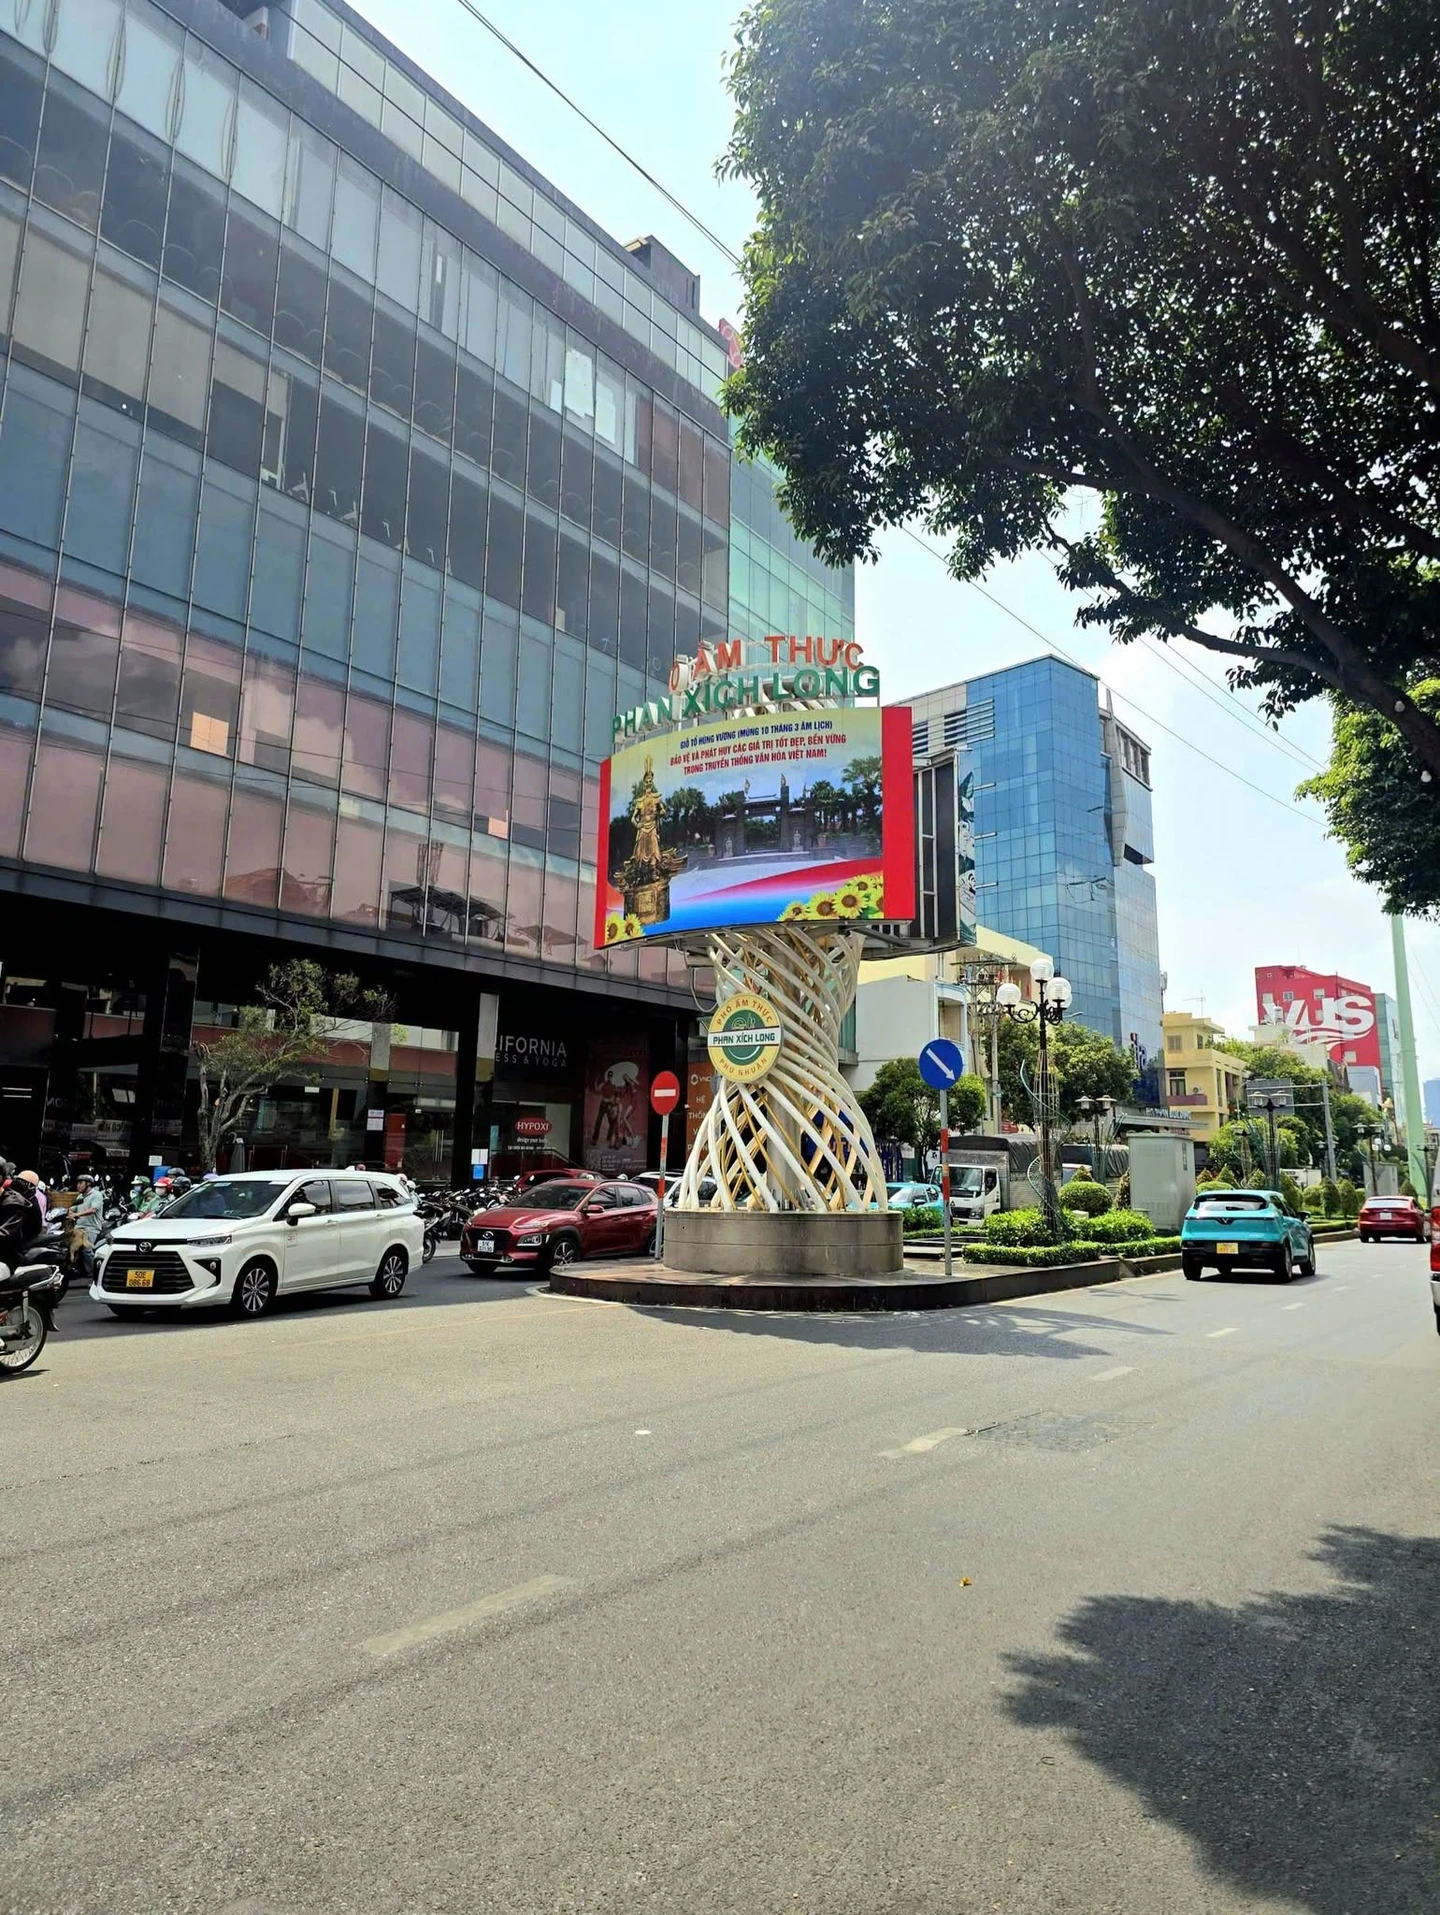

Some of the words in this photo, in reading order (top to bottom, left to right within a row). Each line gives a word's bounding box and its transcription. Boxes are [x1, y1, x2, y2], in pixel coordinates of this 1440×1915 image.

[613, 694, 673, 743] PHAN
[682, 675, 759, 717] XÍCH
[773, 665, 880, 700] LONG
[761, 726, 769, 735] 10
[771, 723, 793, 733] THÁNG
[795, 723, 800, 731] 3
[801, 721, 812, 730] ÂM
[814, 720, 833, 731] LỊCH)
[670, 754, 682, 766] BẢO
[683, 752, 690, 764] VỆ
[692, 750, 700, 761] VÀ
[701, 747, 717, 759] PHÁT
[718, 746, 731, 756] HUY
[733, 742, 747, 753] CÁC
[749, 740, 760, 751] GIÁ
[762, 740, 773, 750] TRỊ
[775, 736, 788, 748] TỐT
[808, 733, 823, 745] BỀN
[826, 732, 846, 744] VỮNG
[684, 763, 703, 775] TRONG
[705, 757, 729, 771] TRUYỀN
[731, 754, 753, 767] THỐNG
[755, 752, 770, 763] VĂN
[788, 749, 804, 761] VIỆT
[806, 748, 827, 759] NAM!
[1262, 995, 1374, 1036] VUS
[495, 1034, 568, 1058] IFORNIA
[713, 1034, 734, 1045] PHAN
[736, 1032, 753, 1044] XÍCH
[755, 1032, 775, 1042] LONG
[535, 1056, 567, 1068] YOGA
[516, 1121, 549, 1131] HYPOXI
